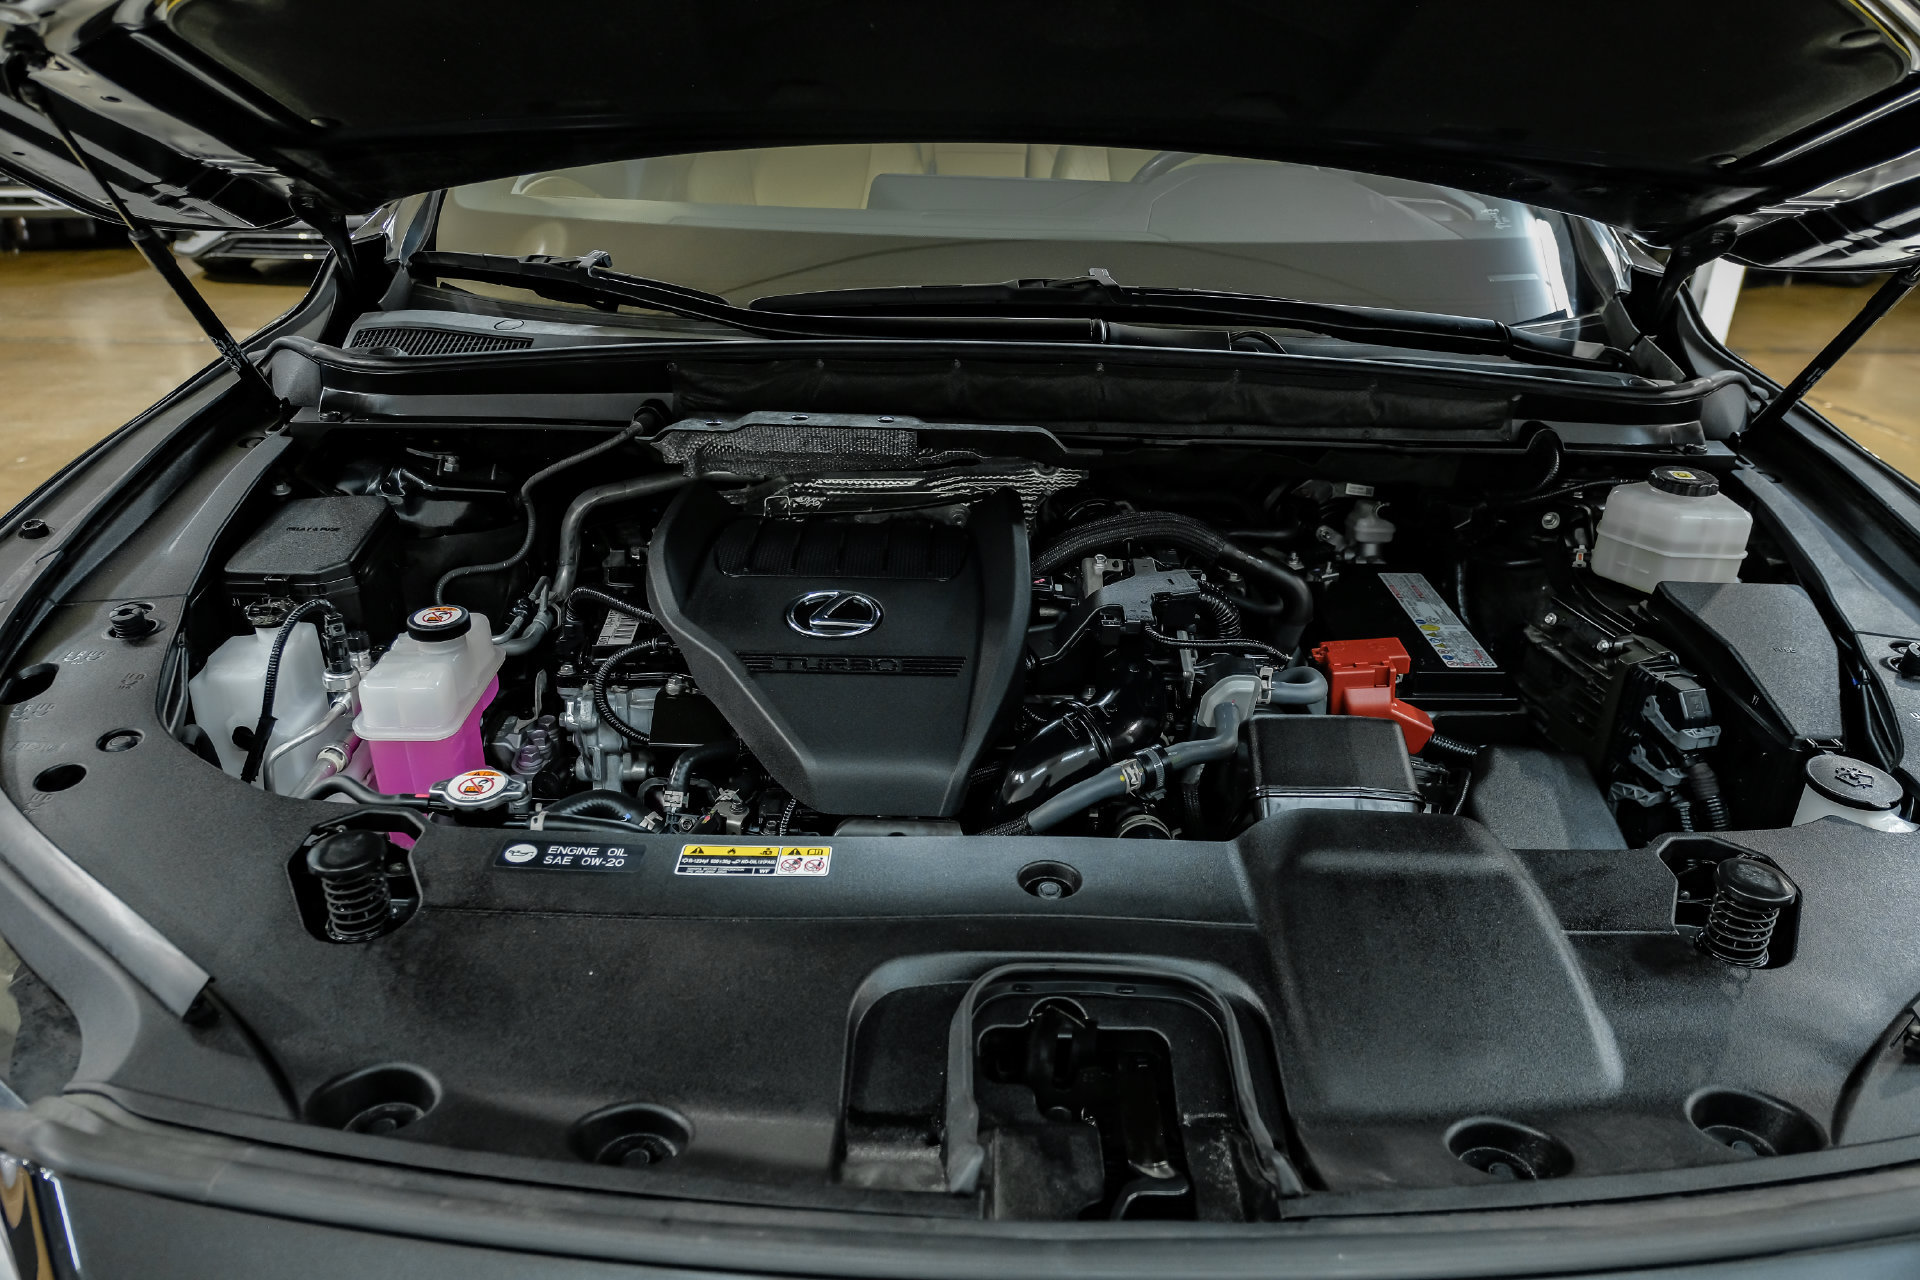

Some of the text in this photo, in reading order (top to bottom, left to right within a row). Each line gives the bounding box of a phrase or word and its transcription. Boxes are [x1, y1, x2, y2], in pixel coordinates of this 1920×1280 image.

[776, 656, 899, 672] TURBO
[548, 845, 629, 857] ENGINE OIL
[543, 856, 625, 867] SAE 0W-20
